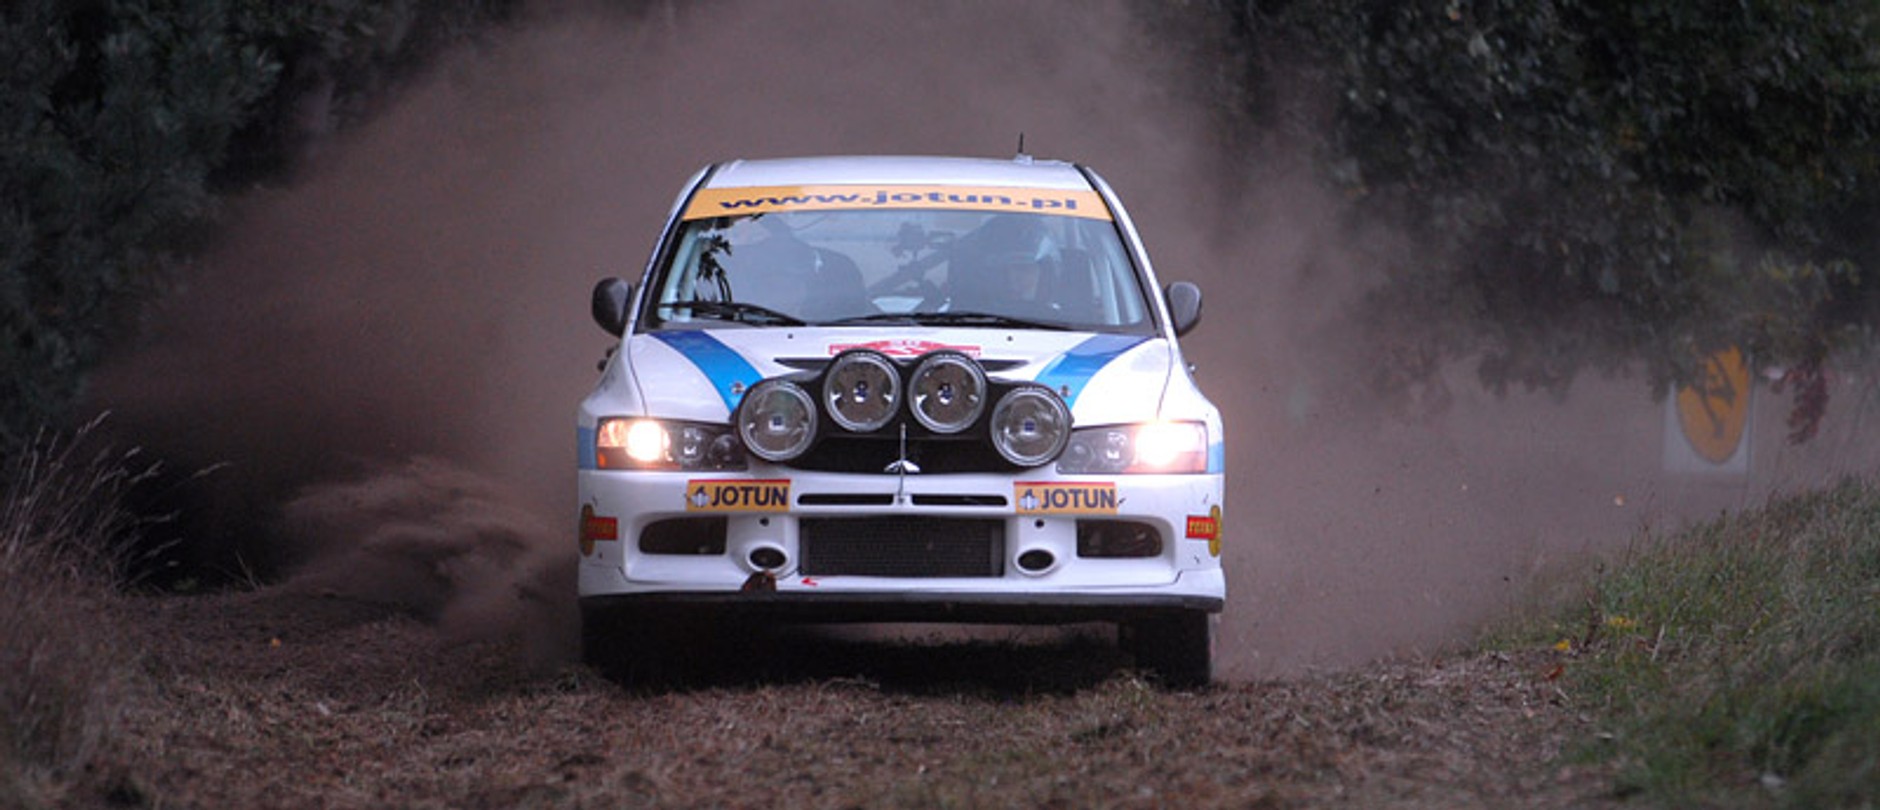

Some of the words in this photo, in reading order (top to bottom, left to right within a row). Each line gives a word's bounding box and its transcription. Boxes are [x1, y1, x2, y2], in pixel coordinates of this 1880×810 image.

[719, 191, 1078, 210] www.jotun.pl
[711, 486, 788, 506] JOTUN
[1041, 488, 1115, 509] JOTUN
